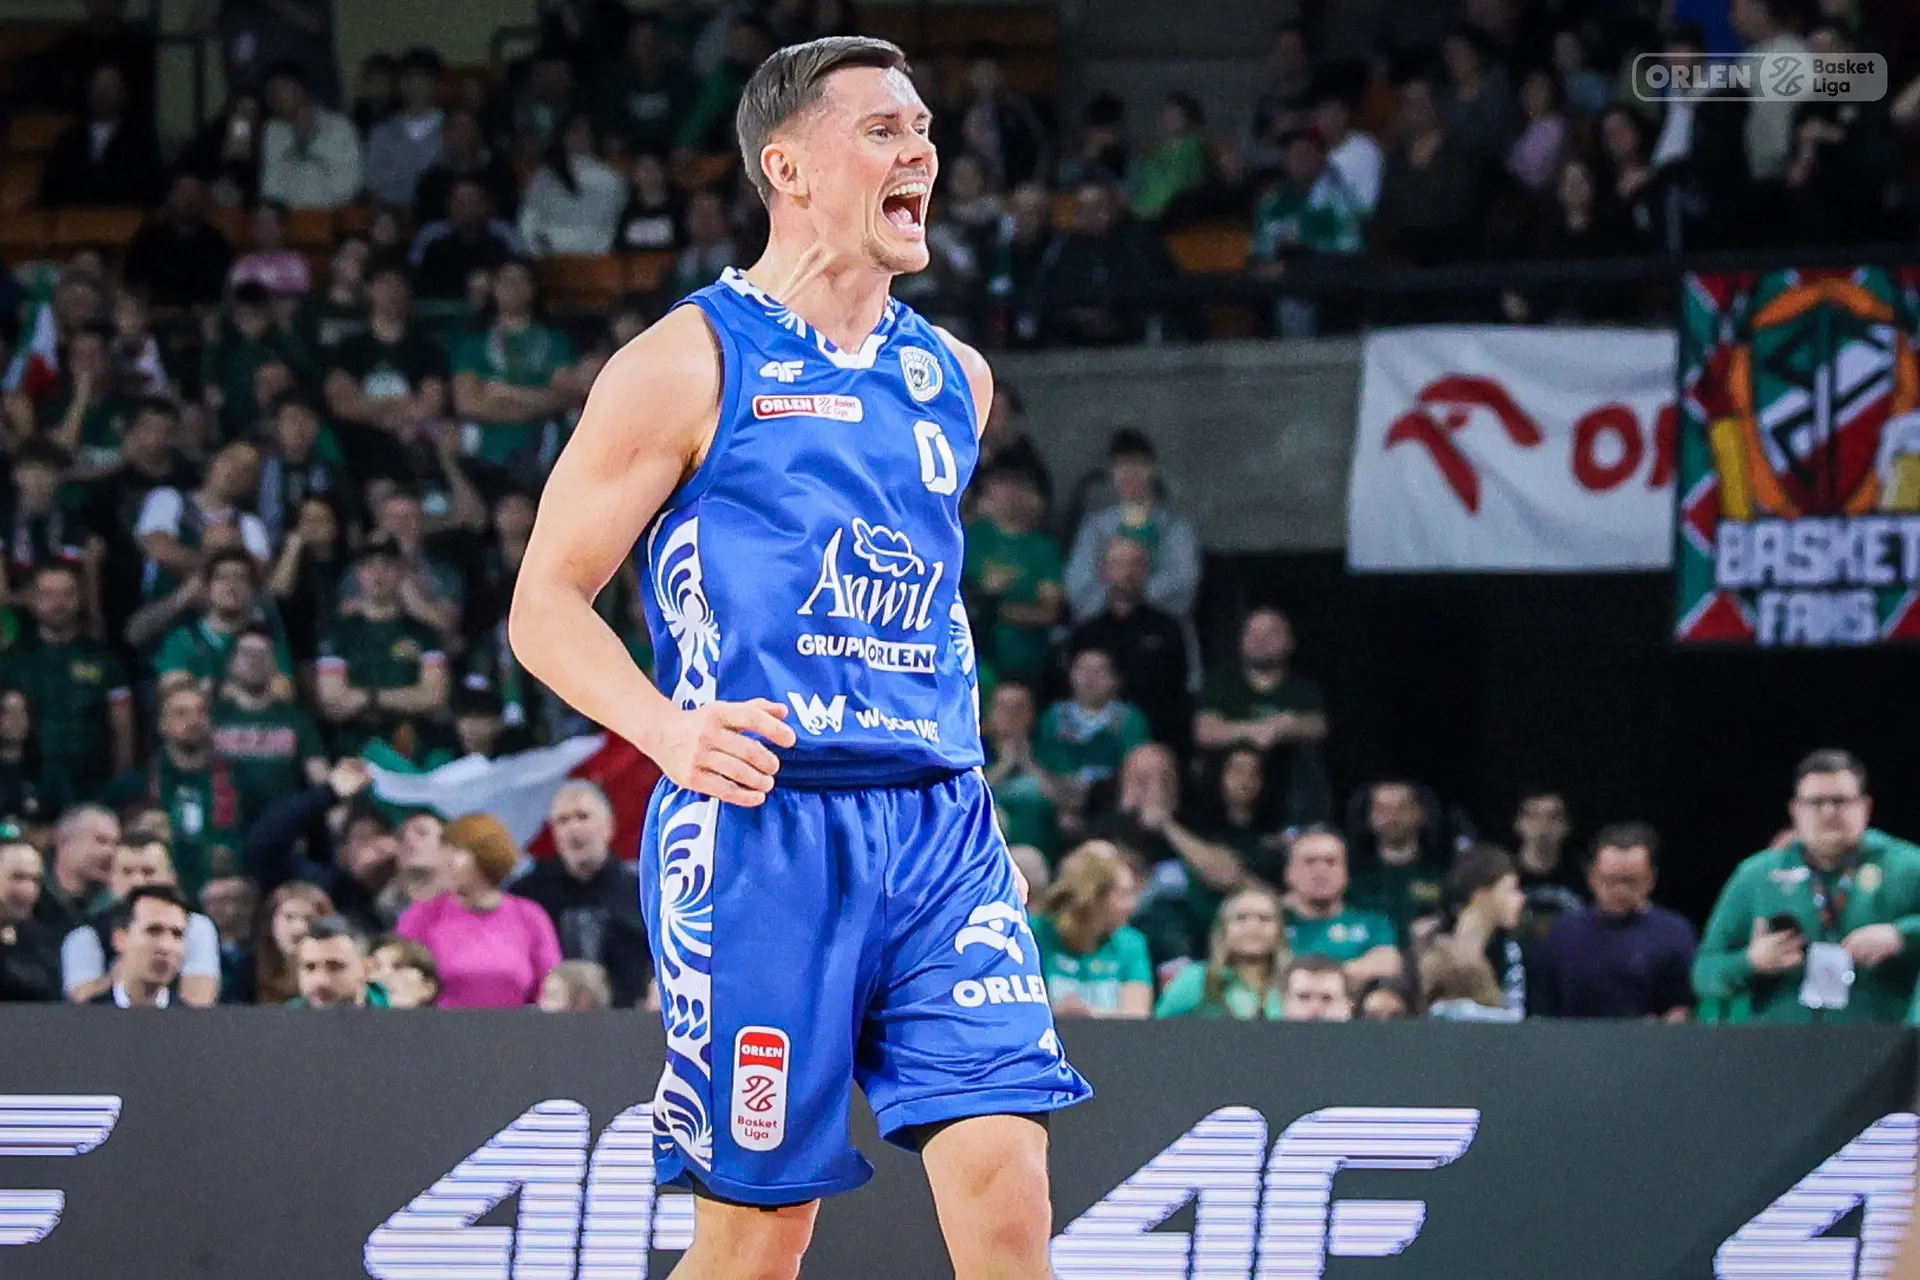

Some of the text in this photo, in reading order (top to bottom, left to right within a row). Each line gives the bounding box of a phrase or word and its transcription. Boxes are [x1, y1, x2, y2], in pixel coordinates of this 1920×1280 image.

[759, 360, 805, 383] 4F
[760, 398, 813, 413] ORLEN
[913, 420, 957, 496] 0
[1717, 519, 1920, 586] BASKET
[797, 527, 944, 631] Anwil
[867, 643, 932, 669] ORLEN
[741, 1043, 783, 1058] ORLEN
[737, 1115, 778, 1129] Basket
[744, 1127, 769, 1141] Liga
[1050, 1105, 1482, 1280] 4F
